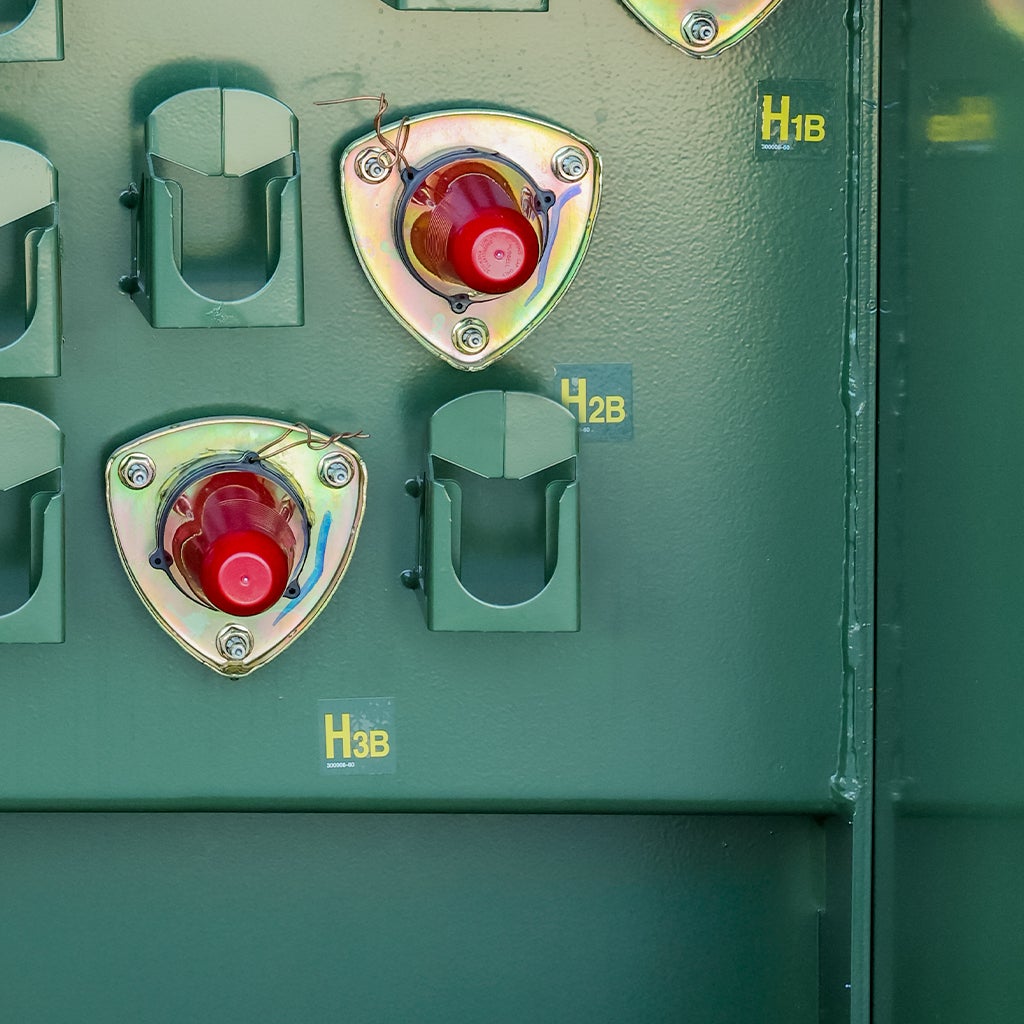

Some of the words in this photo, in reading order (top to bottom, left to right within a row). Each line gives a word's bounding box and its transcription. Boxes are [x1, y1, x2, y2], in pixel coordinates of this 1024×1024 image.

[761, 94, 826, 142] H1B
[560, 378, 626, 424] H2B
[324, 713, 391, 759] H3B
